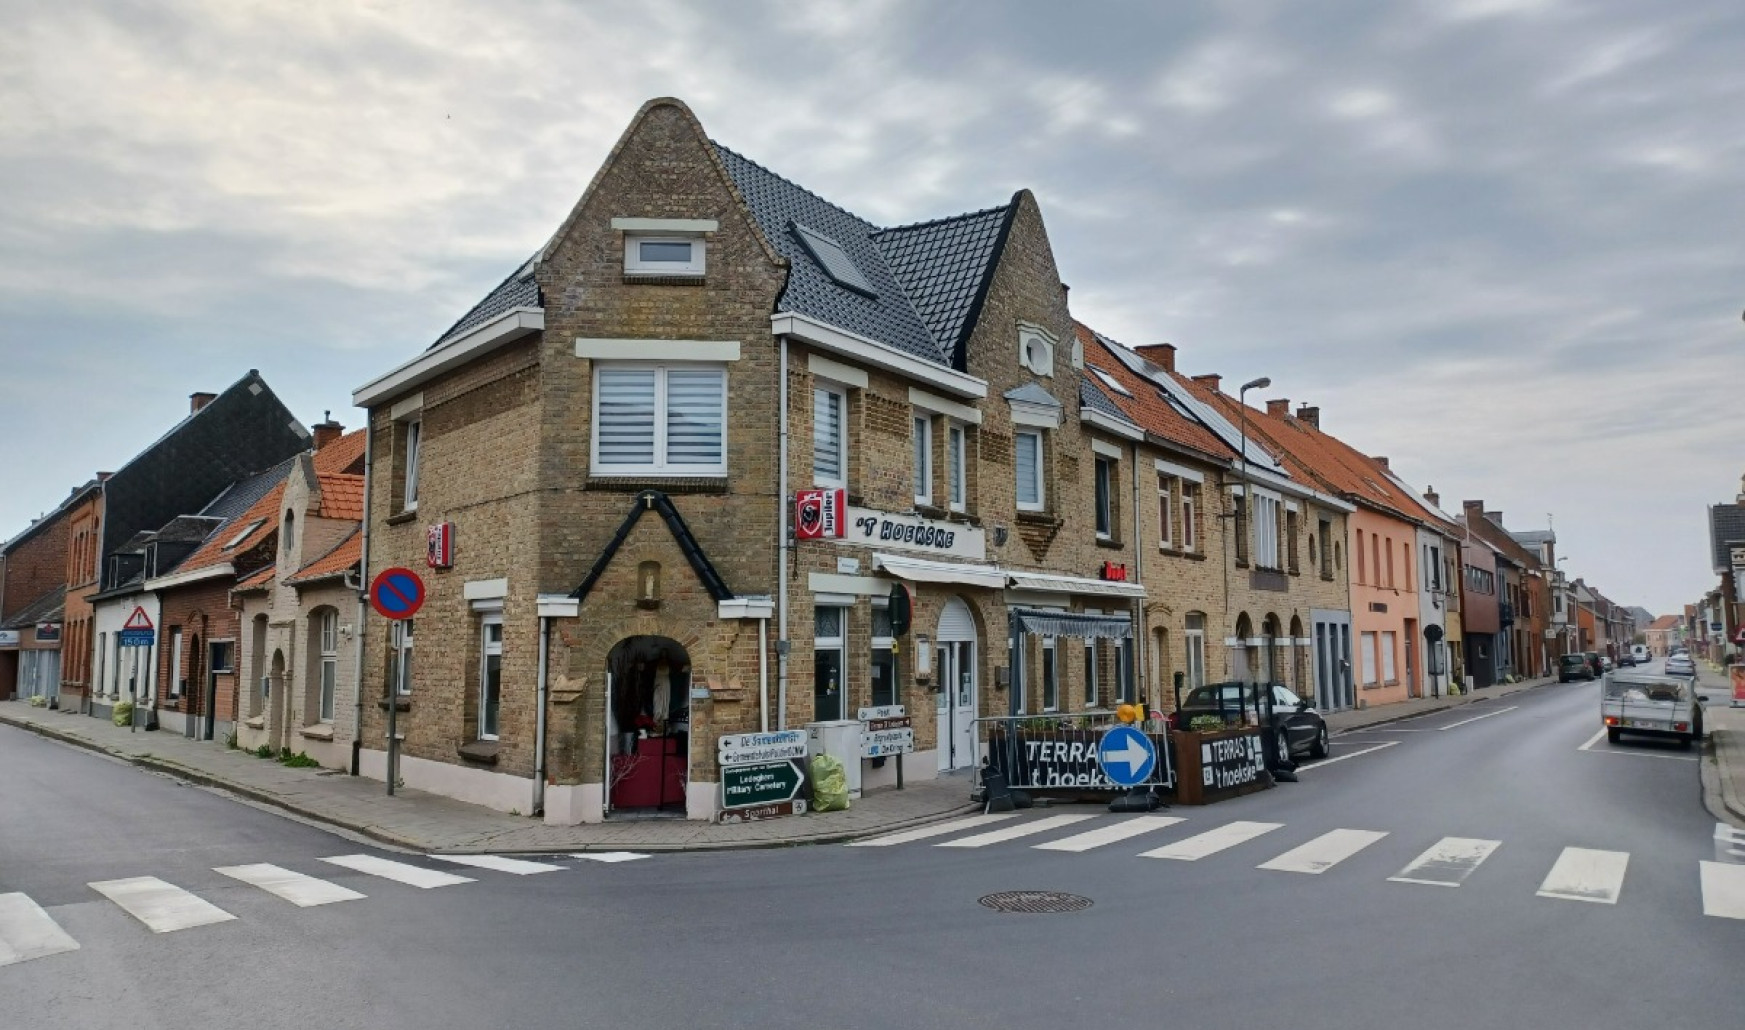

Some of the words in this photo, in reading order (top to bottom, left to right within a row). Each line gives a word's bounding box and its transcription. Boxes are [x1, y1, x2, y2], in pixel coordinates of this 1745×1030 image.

[824, 492, 834, 533] Jupiler
[880, 520, 955, 549] HOEKSKE
[1025, 740, 1099, 763] TERRA
[1212, 736, 1246, 763] TERRAS
[1222, 762, 1257, 788] hoekske
